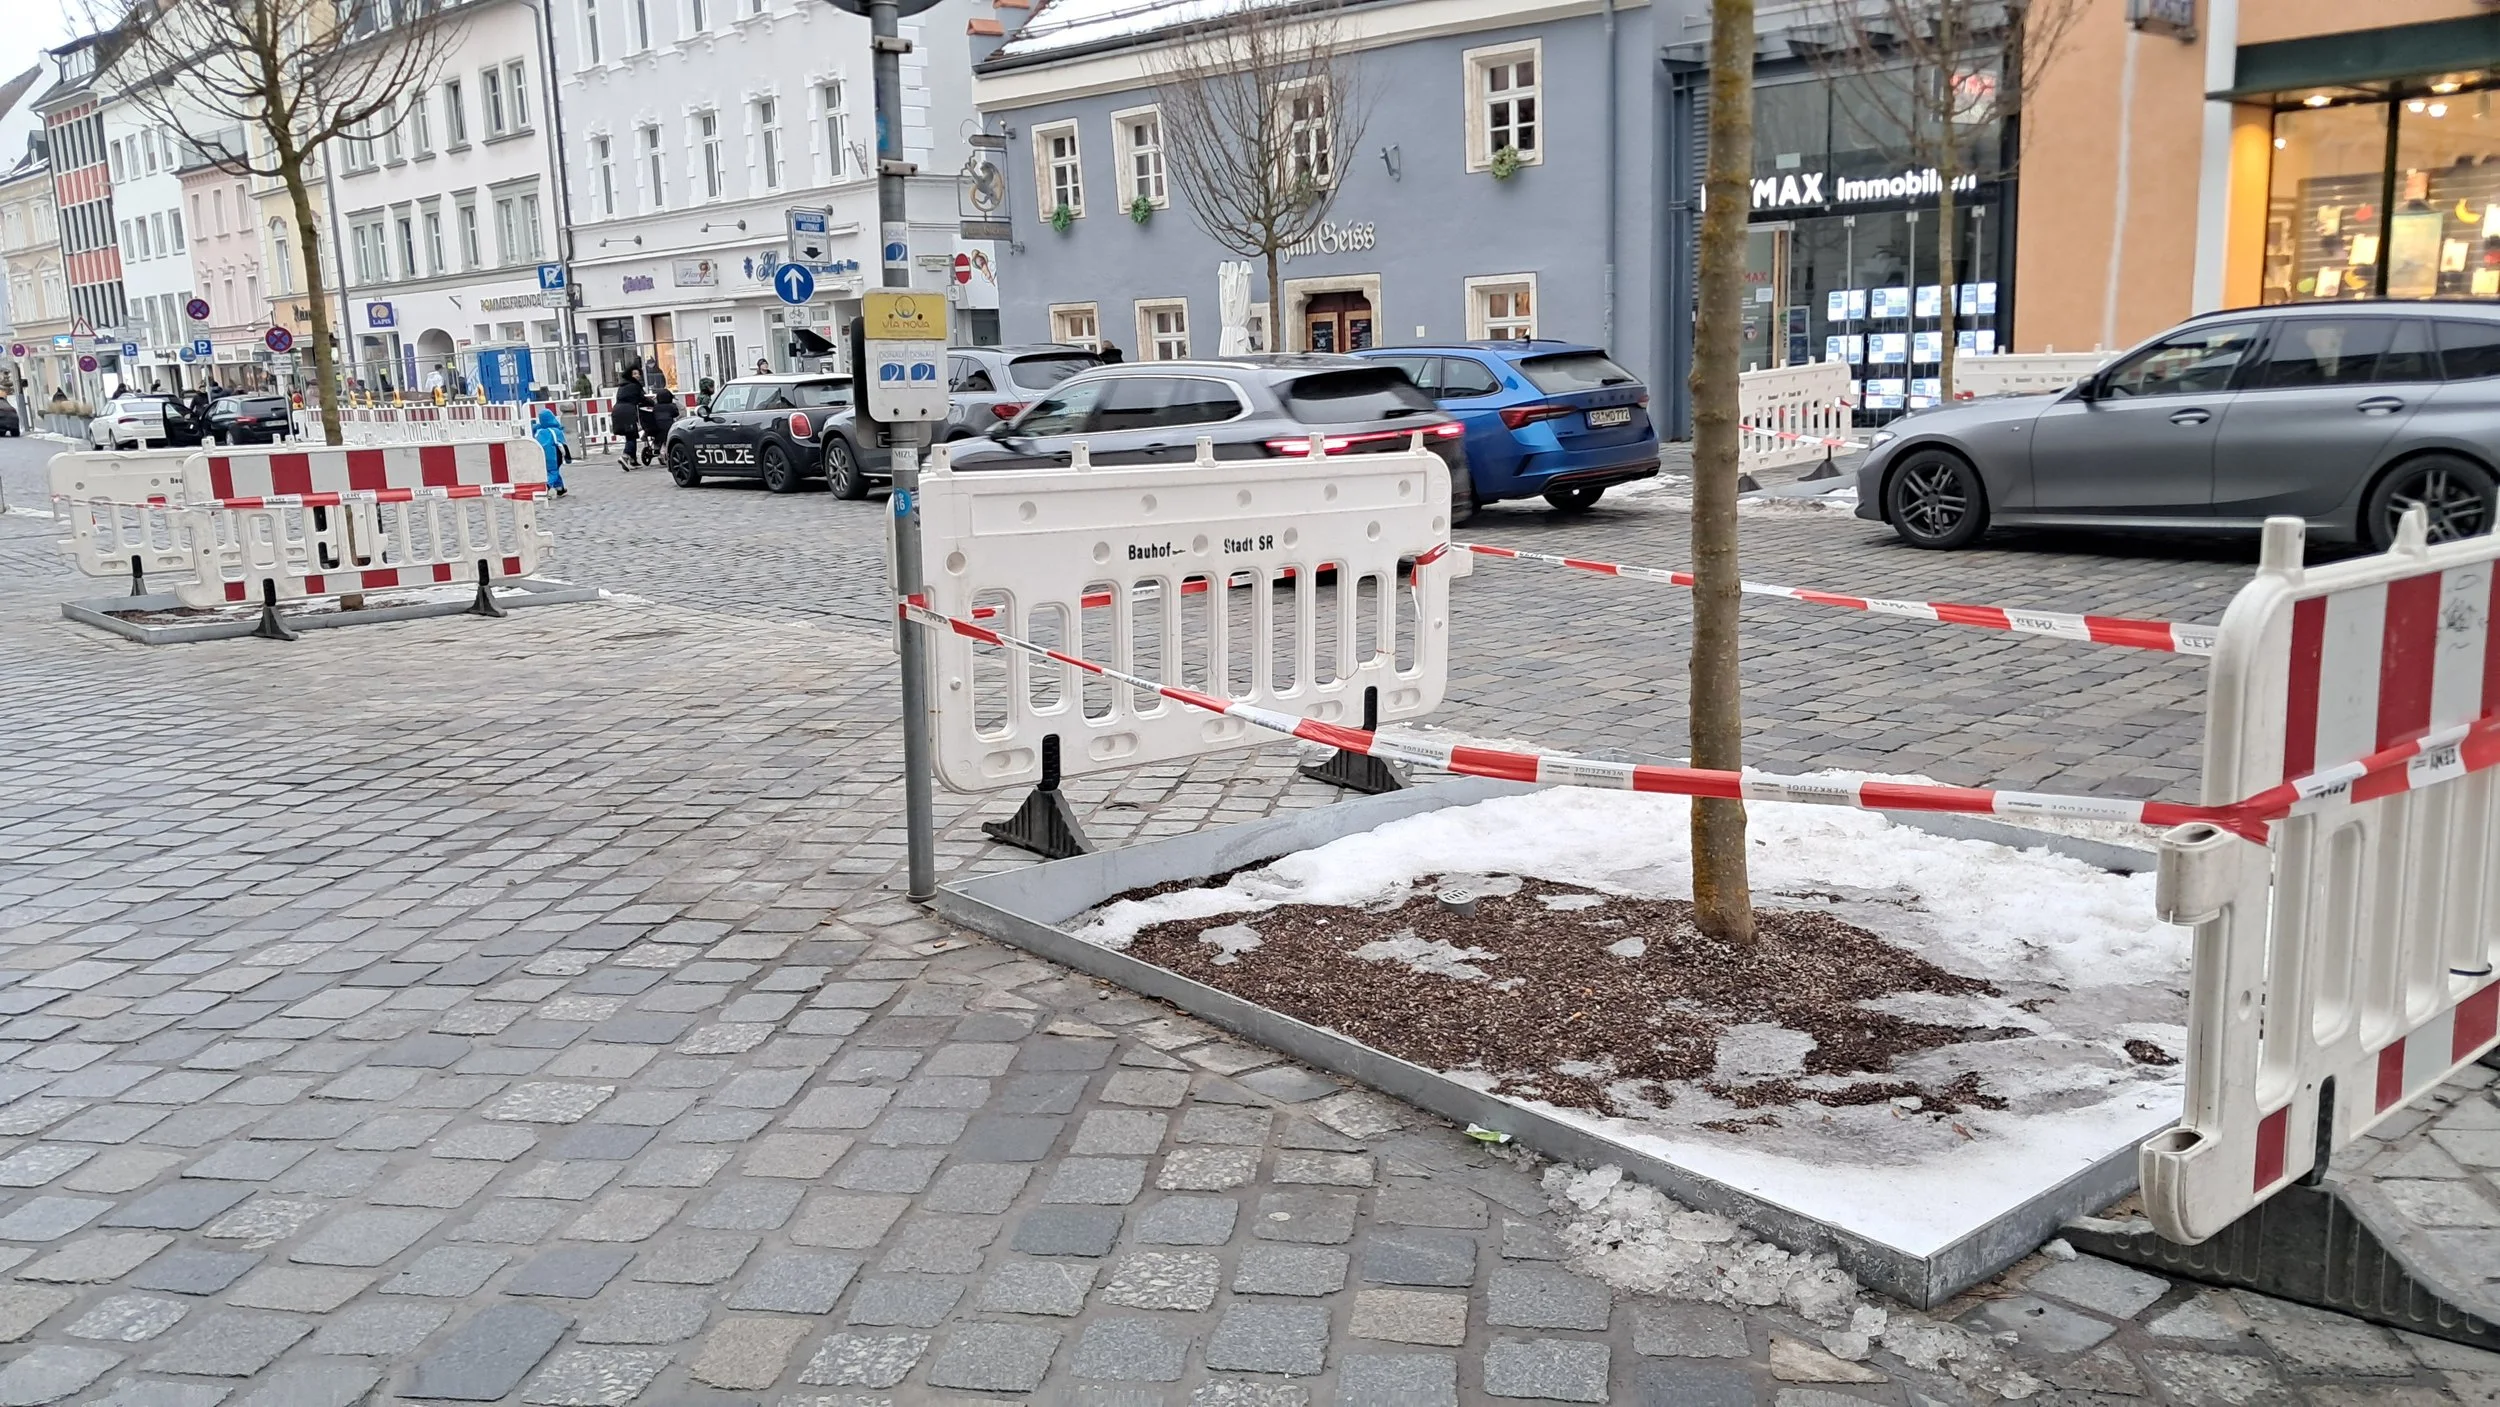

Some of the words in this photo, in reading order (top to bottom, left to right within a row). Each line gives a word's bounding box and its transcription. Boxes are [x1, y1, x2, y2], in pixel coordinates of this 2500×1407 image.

[695, 449, 755, 464] STOLZE
[1224, 537, 1253, 554] Stadt
[1259, 535, 1274, 551] SR
